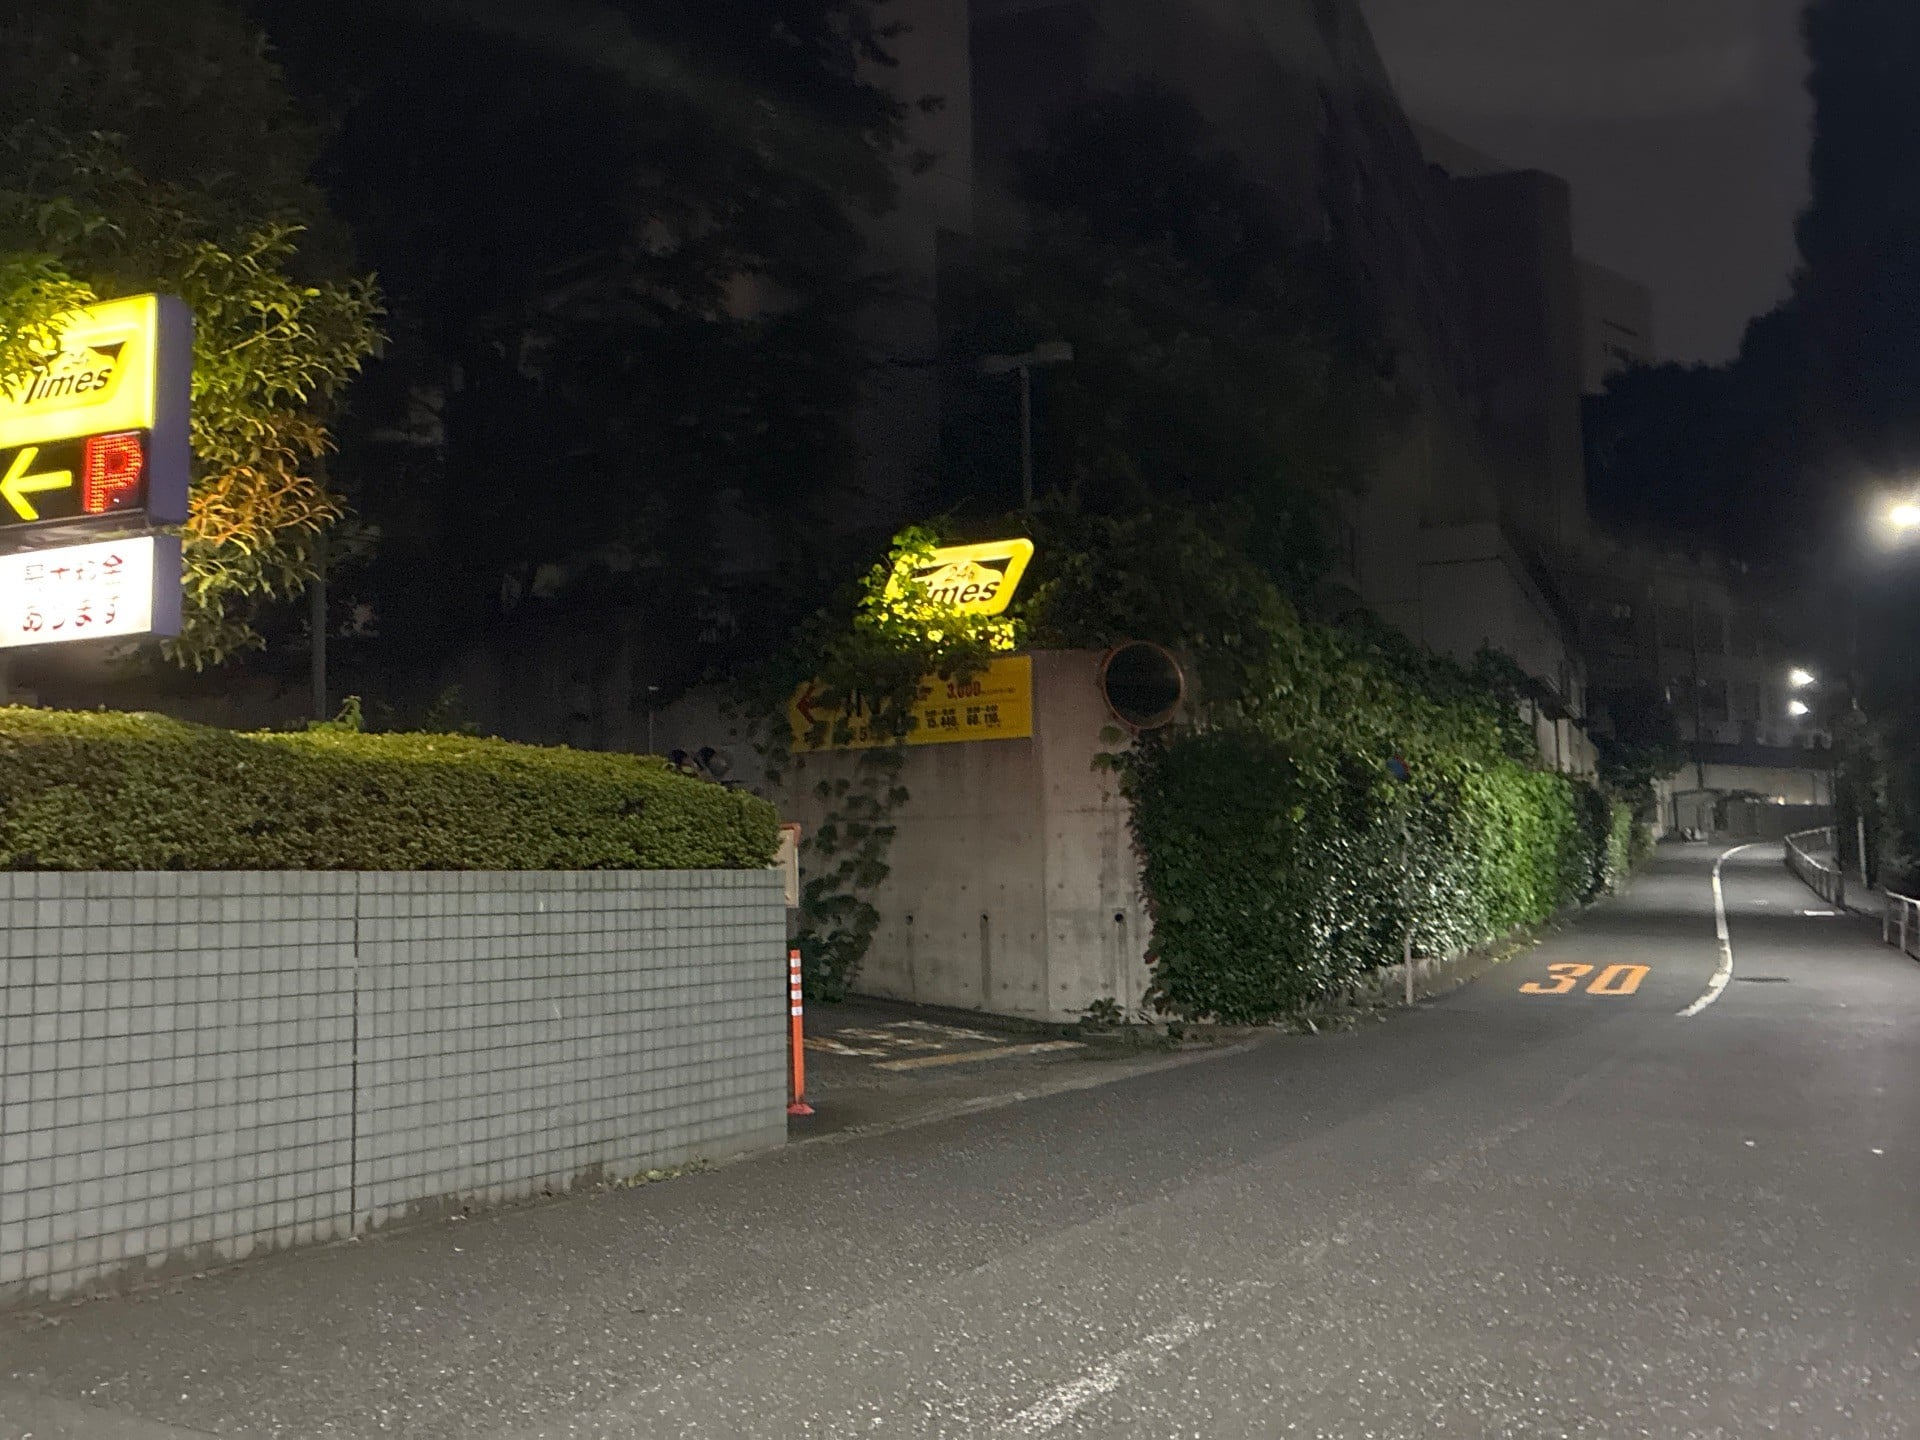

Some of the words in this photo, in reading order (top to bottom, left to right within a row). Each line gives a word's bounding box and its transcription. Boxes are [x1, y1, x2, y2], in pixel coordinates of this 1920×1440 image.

[83, 436, 143, 514] P
[926, 581, 1002, 607] mes
[1518, 961, 1652, 996] 30
